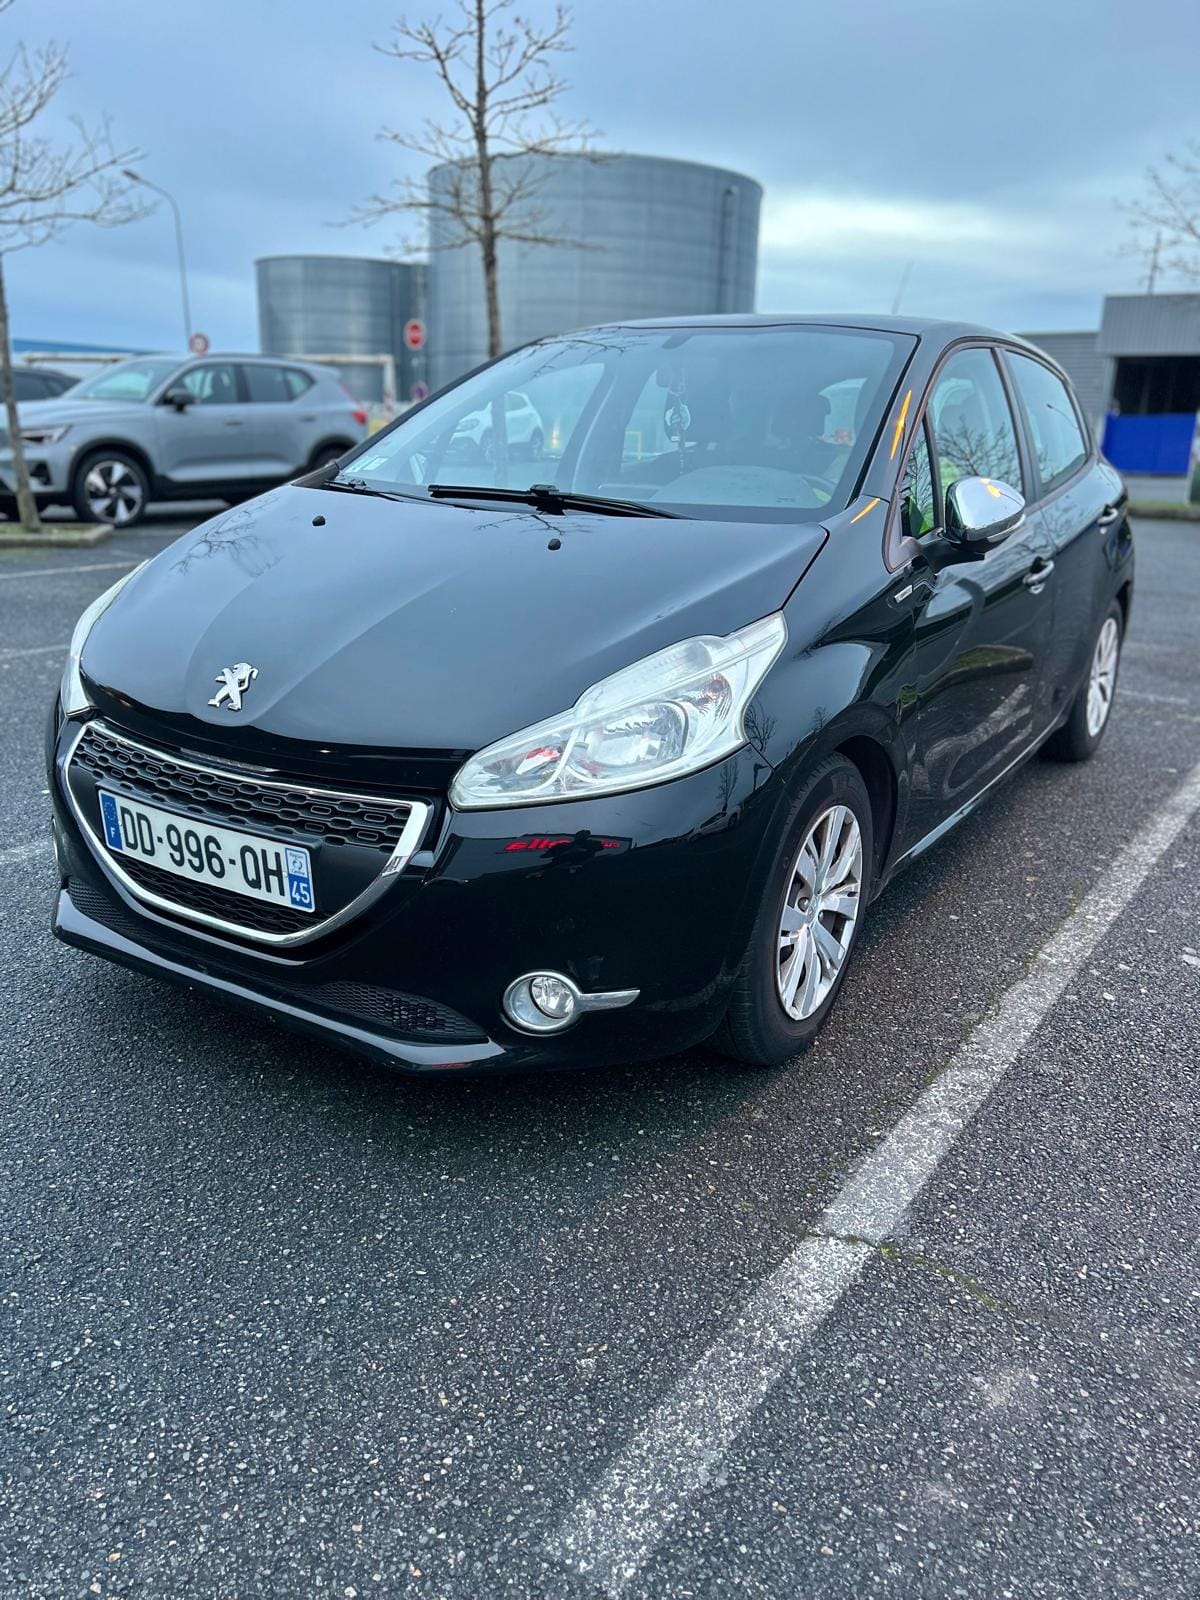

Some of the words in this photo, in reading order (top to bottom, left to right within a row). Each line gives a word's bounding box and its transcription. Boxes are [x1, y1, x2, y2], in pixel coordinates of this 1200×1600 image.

[110, 827, 115, 838] F
[119, 806, 286, 897] DD-996-QH
[291, 880, 310, 904] 45
